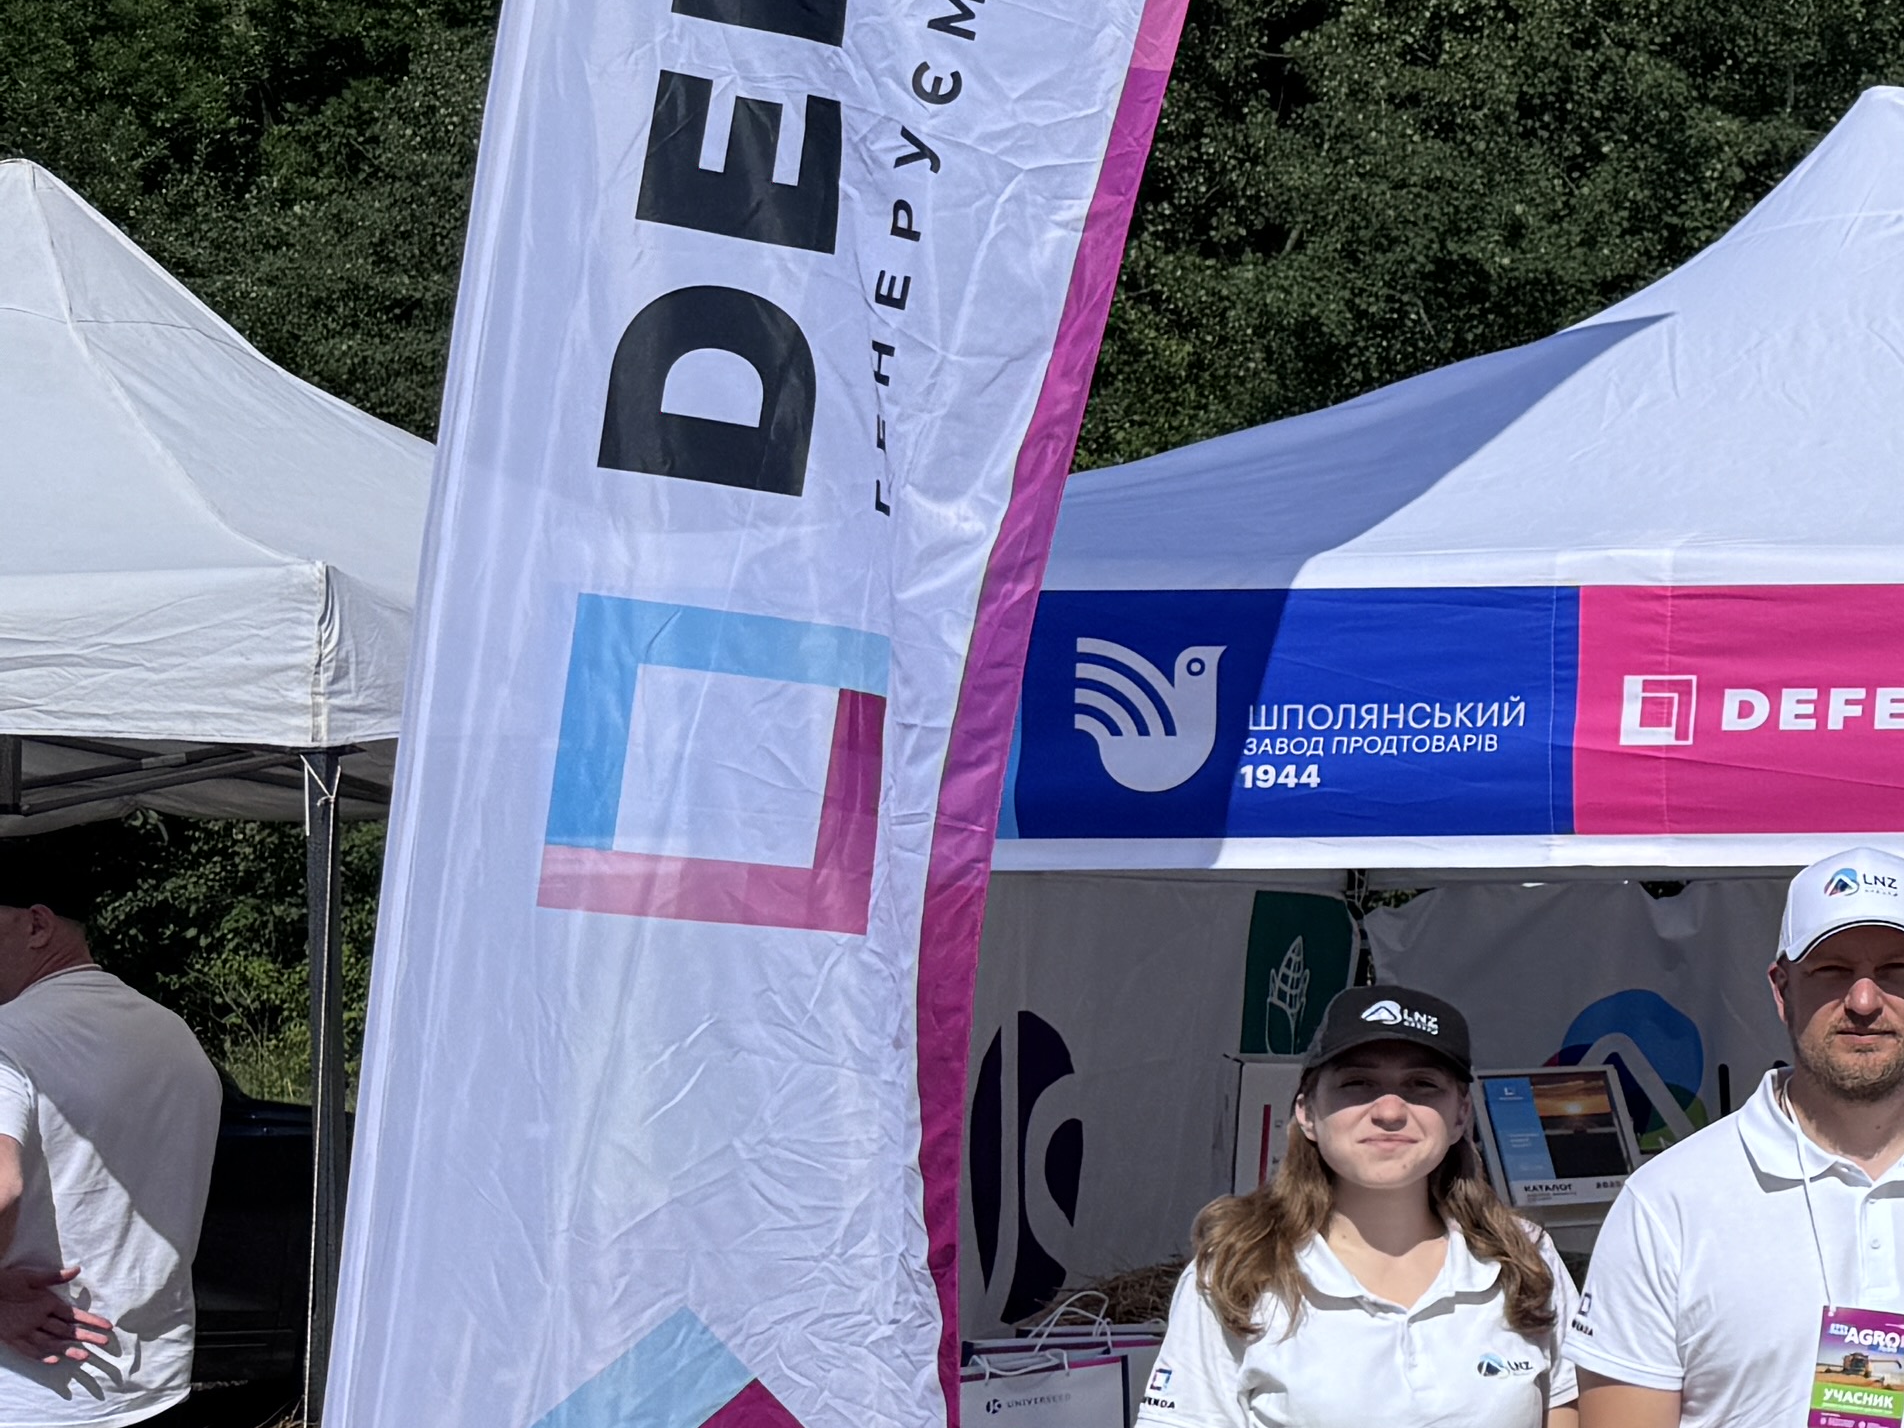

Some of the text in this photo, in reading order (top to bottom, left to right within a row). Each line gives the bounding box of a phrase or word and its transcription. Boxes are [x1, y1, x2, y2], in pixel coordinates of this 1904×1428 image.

[1247, 695, 1527, 731] ШПОЛЯНСЬКИЙ
[1242, 732, 1500, 758] ЗАВОД ПРОДТОВАРІВ
[1239, 763, 1322, 790] 1944
[1862, 872, 1898, 890] LNZ
[1006, 1393, 1071, 1409] UNIVERSEED
[1822, 1387, 1894, 1409] УЧАСНИК
